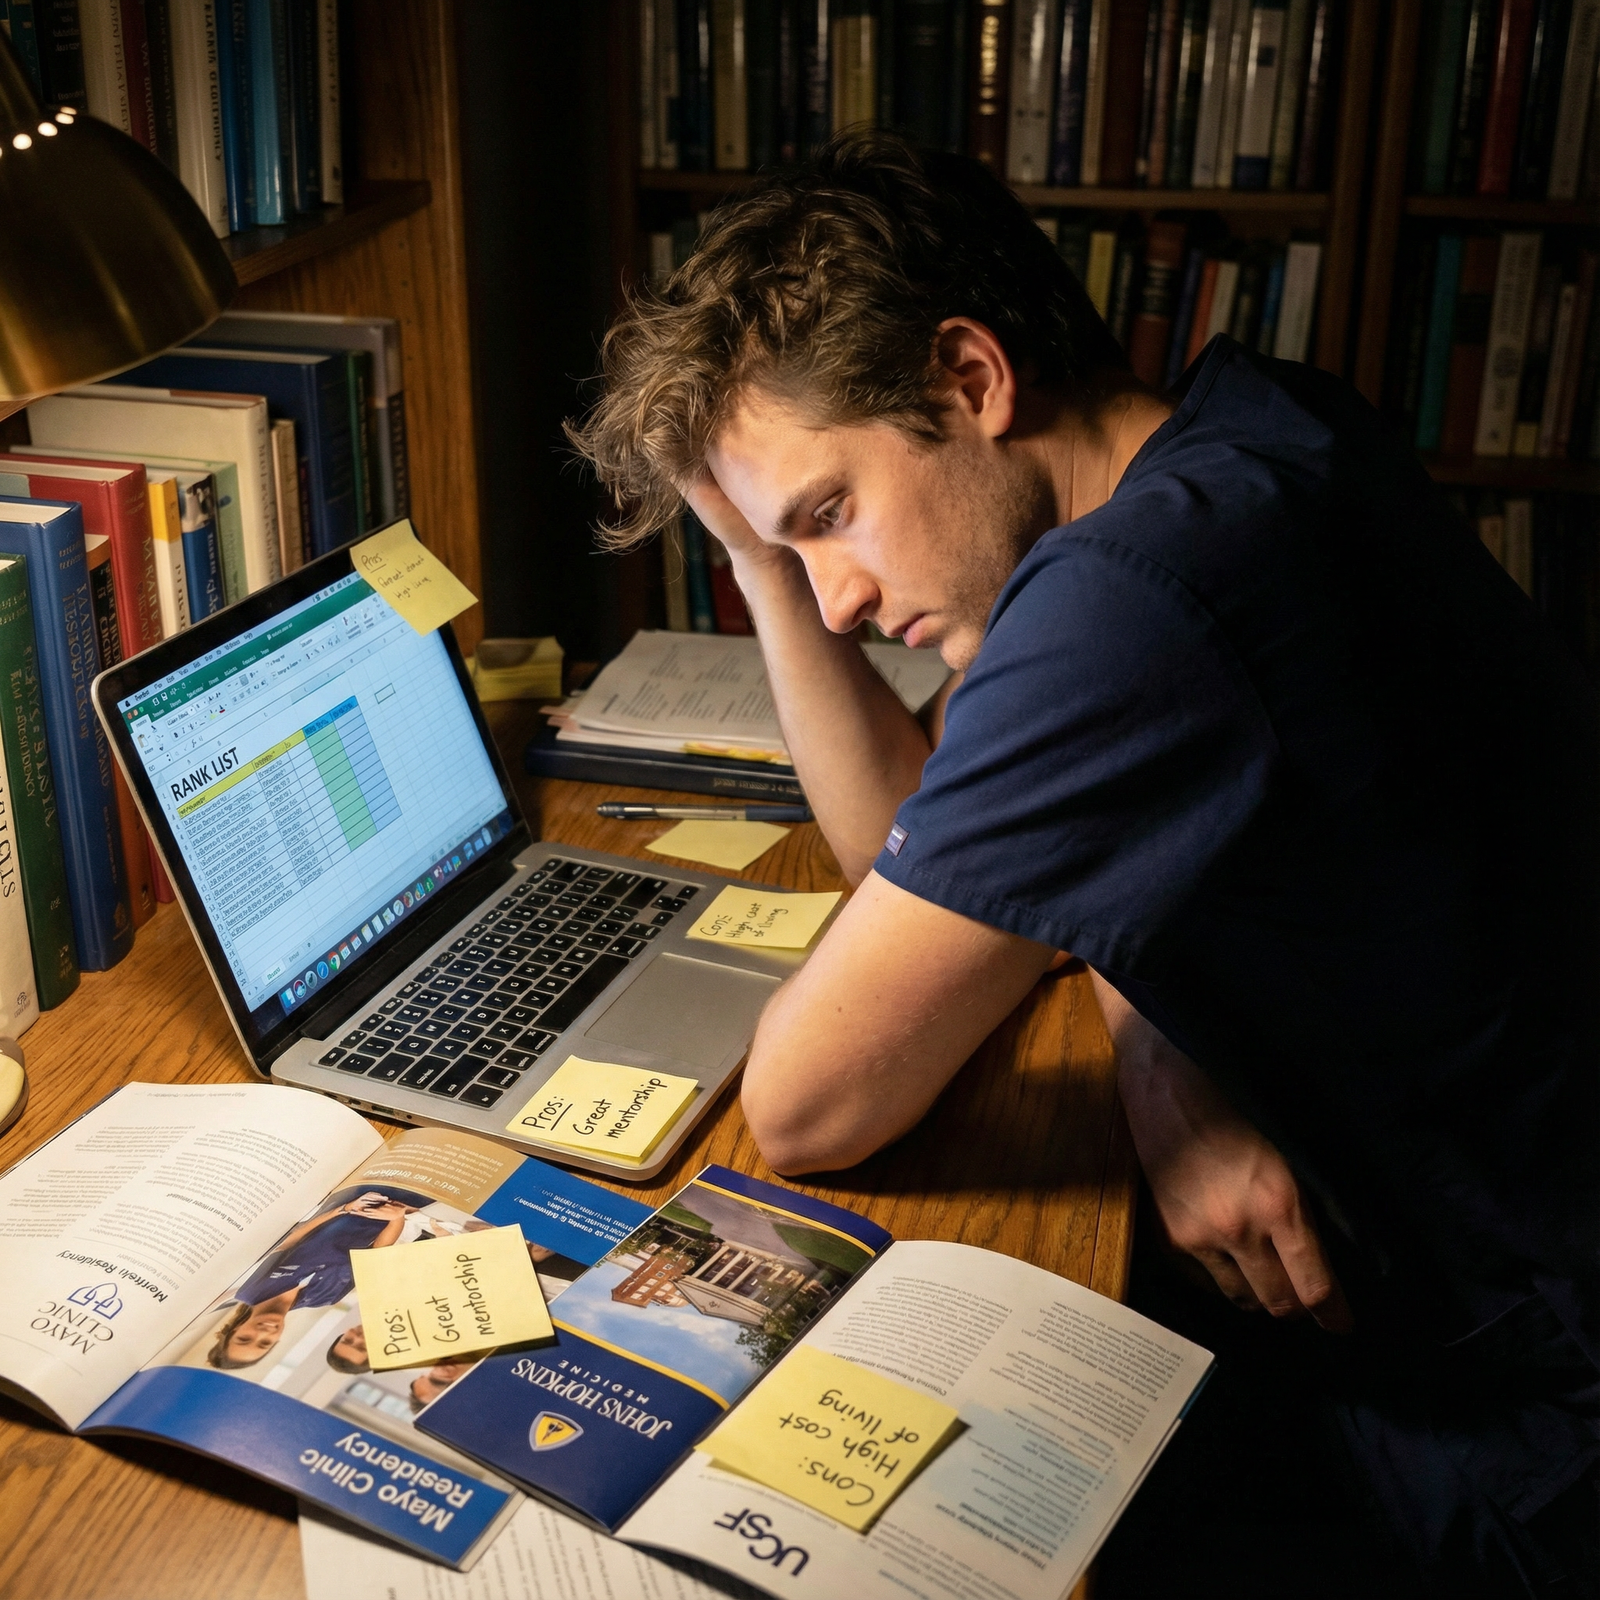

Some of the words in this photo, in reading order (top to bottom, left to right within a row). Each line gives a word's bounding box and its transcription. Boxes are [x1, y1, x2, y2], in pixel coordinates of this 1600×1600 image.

[171, 765, 212, 801] RANK
[211, 747, 239, 776] LIST
[521, 1096, 564, 1129] Pros:
[572, 1098, 612, 1135] Great
[604, 1077, 667, 1138] mentorship
[455, 1253, 495, 1335] mentorship
[30, 1317, 96, 1355] MAYO
[38, 1301, 114, 1341] CLINIC
[384, 1308, 412, 1356] Pros:
[425, 1295, 460, 1343] Great
[511, 1358, 604, 1412] HOPKINS
[558, 1360, 650, 1404] MEDICINE
[600, 1394, 672, 1439] JOHNS
[779, 1411, 833, 1439] cost
[818, 1389, 883, 1436] living
[890, 1421, 921, 1448] of
[300, 1449, 375, 1494] Clinic
[335, 1432, 474, 1508] Residency
[842, 1436, 900, 1479] High
[797, 1456, 875, 1507] Cons:
[377, 1485, 455, 1532] Mayo
[714, 1506, 808, 1577] UCSF
